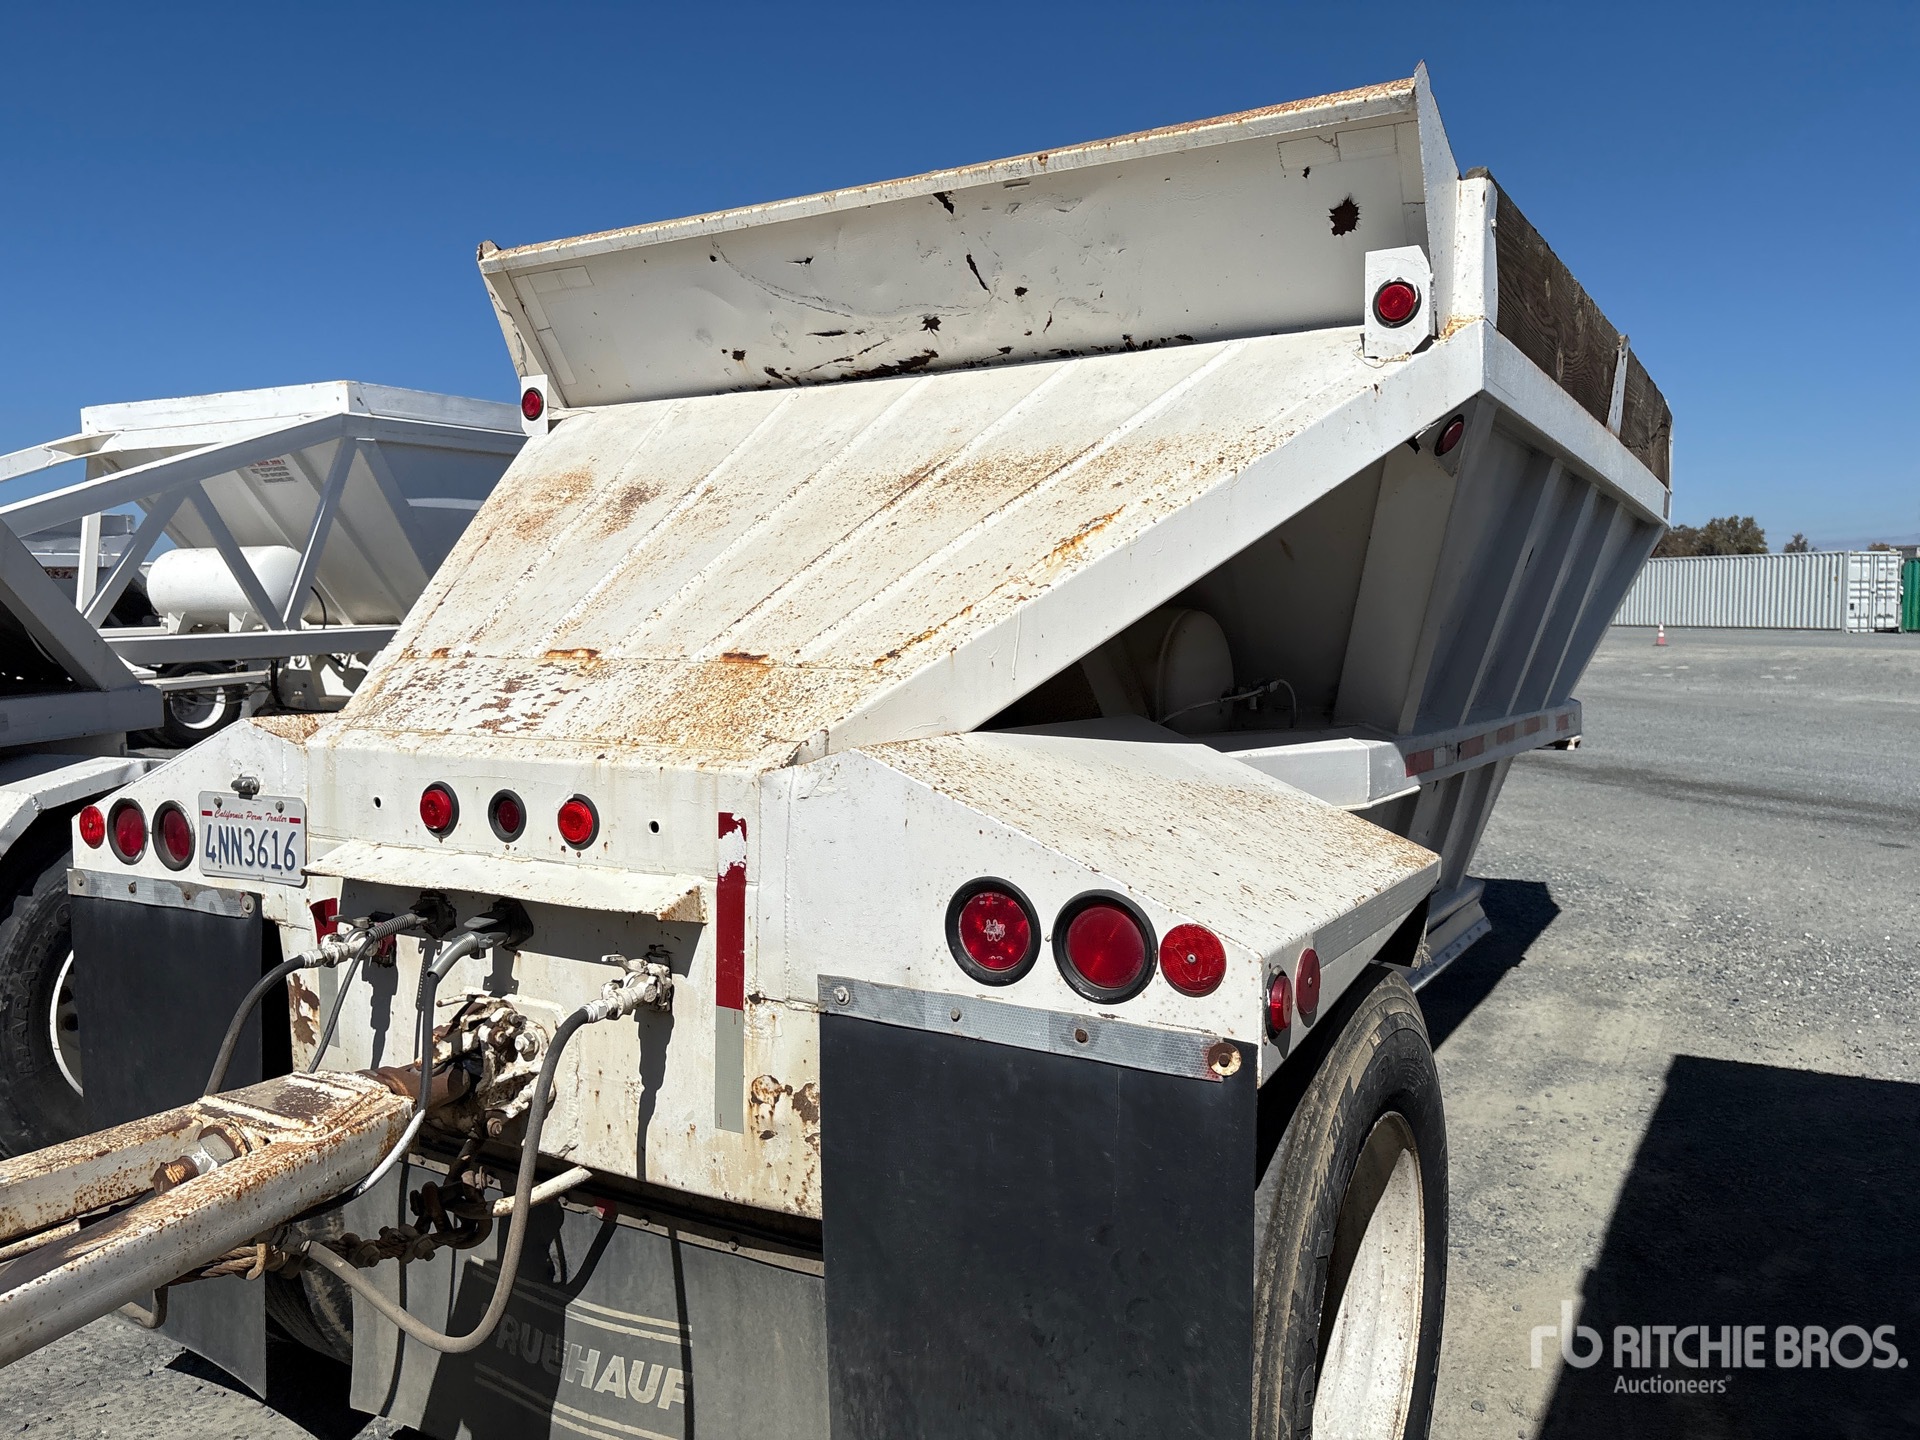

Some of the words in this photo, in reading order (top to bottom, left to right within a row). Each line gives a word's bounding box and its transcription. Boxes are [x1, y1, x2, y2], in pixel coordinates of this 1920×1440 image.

[214, 808, 244, 821] California
[245, 810, 262, 821] Perm
[265, 812, 287, 823] Trailer
[205, 824, 297, 871] 4NN3616
[480, 1303, 693, 1411] RUEHAUF
